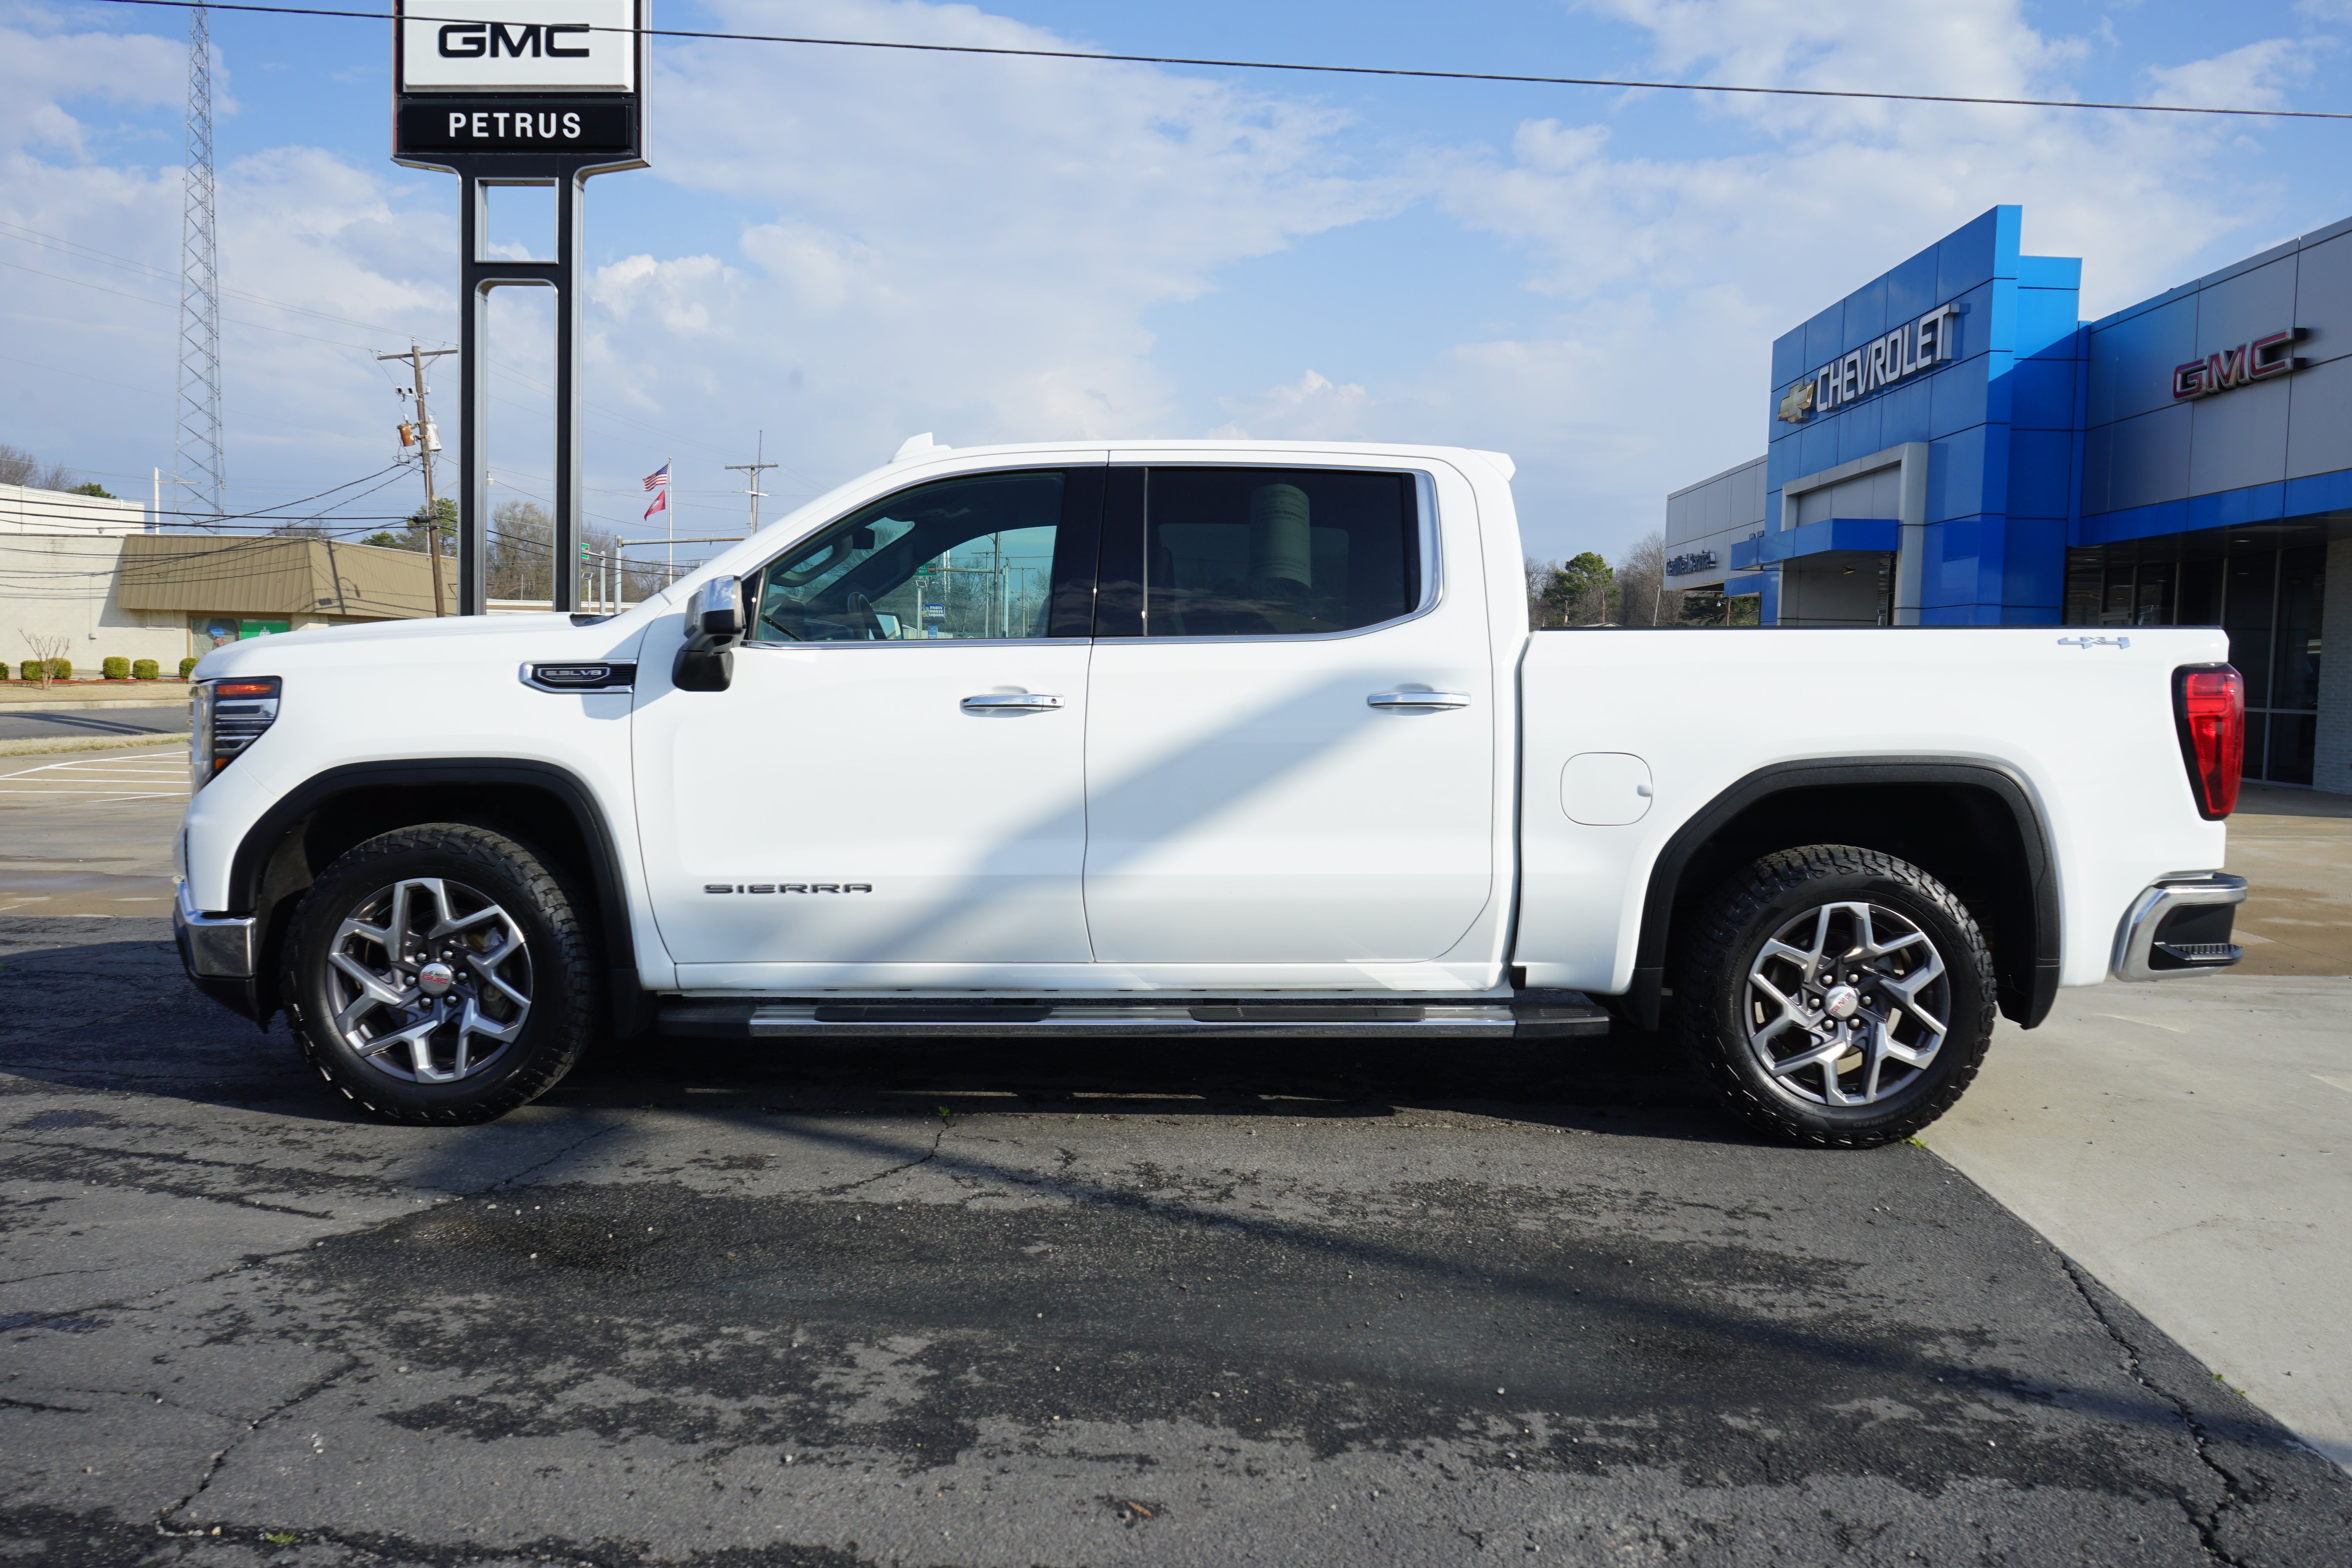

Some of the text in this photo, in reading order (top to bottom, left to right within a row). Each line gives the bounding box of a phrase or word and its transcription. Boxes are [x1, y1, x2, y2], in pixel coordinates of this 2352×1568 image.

[439, 24, 590, 58] GMC
[449, 113, 581, 138] PETRUS
[1816, 303, 1958, 412] CHEVROLET
[2172, 327, 2296, 402] GMC
[704, 883, 873, 894] SIERRA
[421, 974, 449, 984] GMC
[1831, 992, 1853, 1013] GMC
